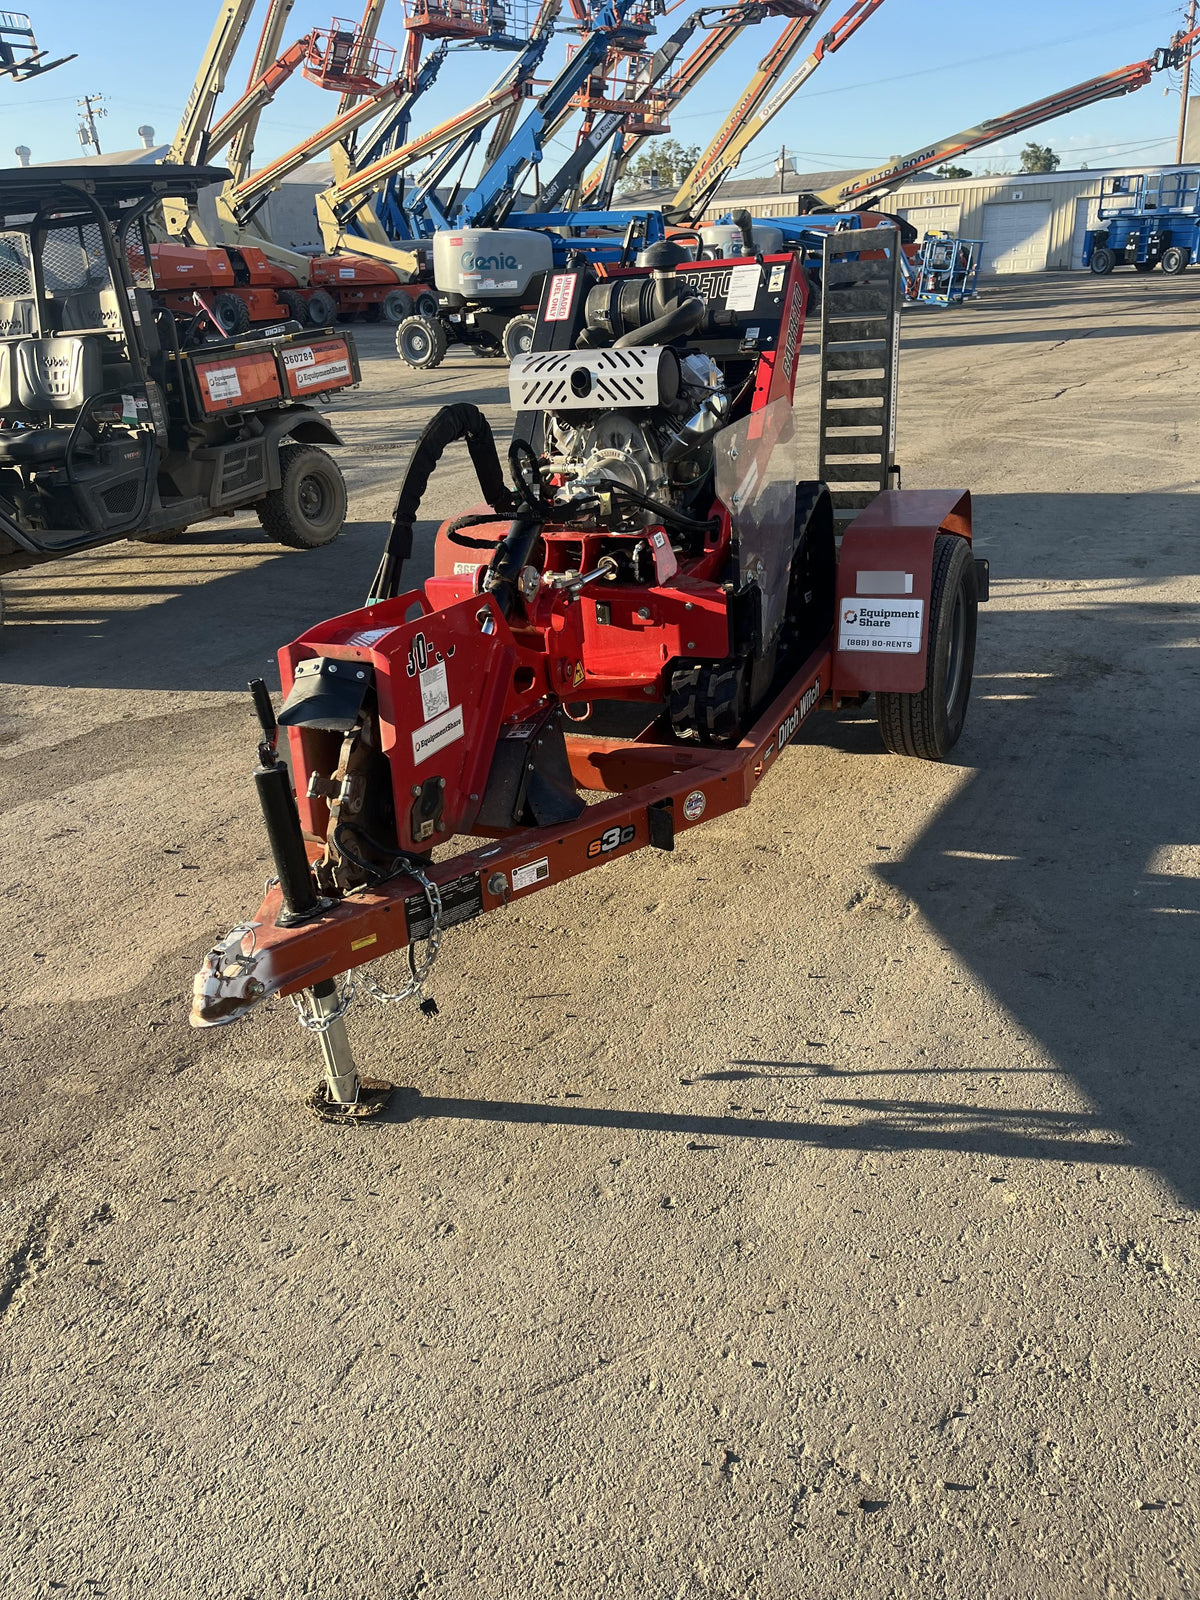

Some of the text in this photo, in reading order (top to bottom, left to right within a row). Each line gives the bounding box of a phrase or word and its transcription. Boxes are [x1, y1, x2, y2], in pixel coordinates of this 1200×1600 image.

[768, 66, 807, 109] EquipmentShare
[695, 157, 725, 195] JLG LIFT
[866, 166, 899, 186] ULTRA
[902, 149, 936, 171] BOOM
[541, 181, 560, 204] SJ66T
[461, 251, 517, 271] Genie
[549, 278, 563, 317] FUEL ONLY
[558, 277, 573, 317] UNLEADED
[782, 281, 803, 383] BARRETO
[43, 357, 69, 367] Kubota
[284, 351, 314, 365] 360784
[304, 364, 347, 381] EquipmentShare
[859, 608, 919, 619] Equipment
[859, 618, 891, 627] Share
[847, 639, 913, 648] (888) 80-RENTS
[778, 678, 820, 750] Ditch Witch
[421, 718, 462, 747] EquipmentShare
